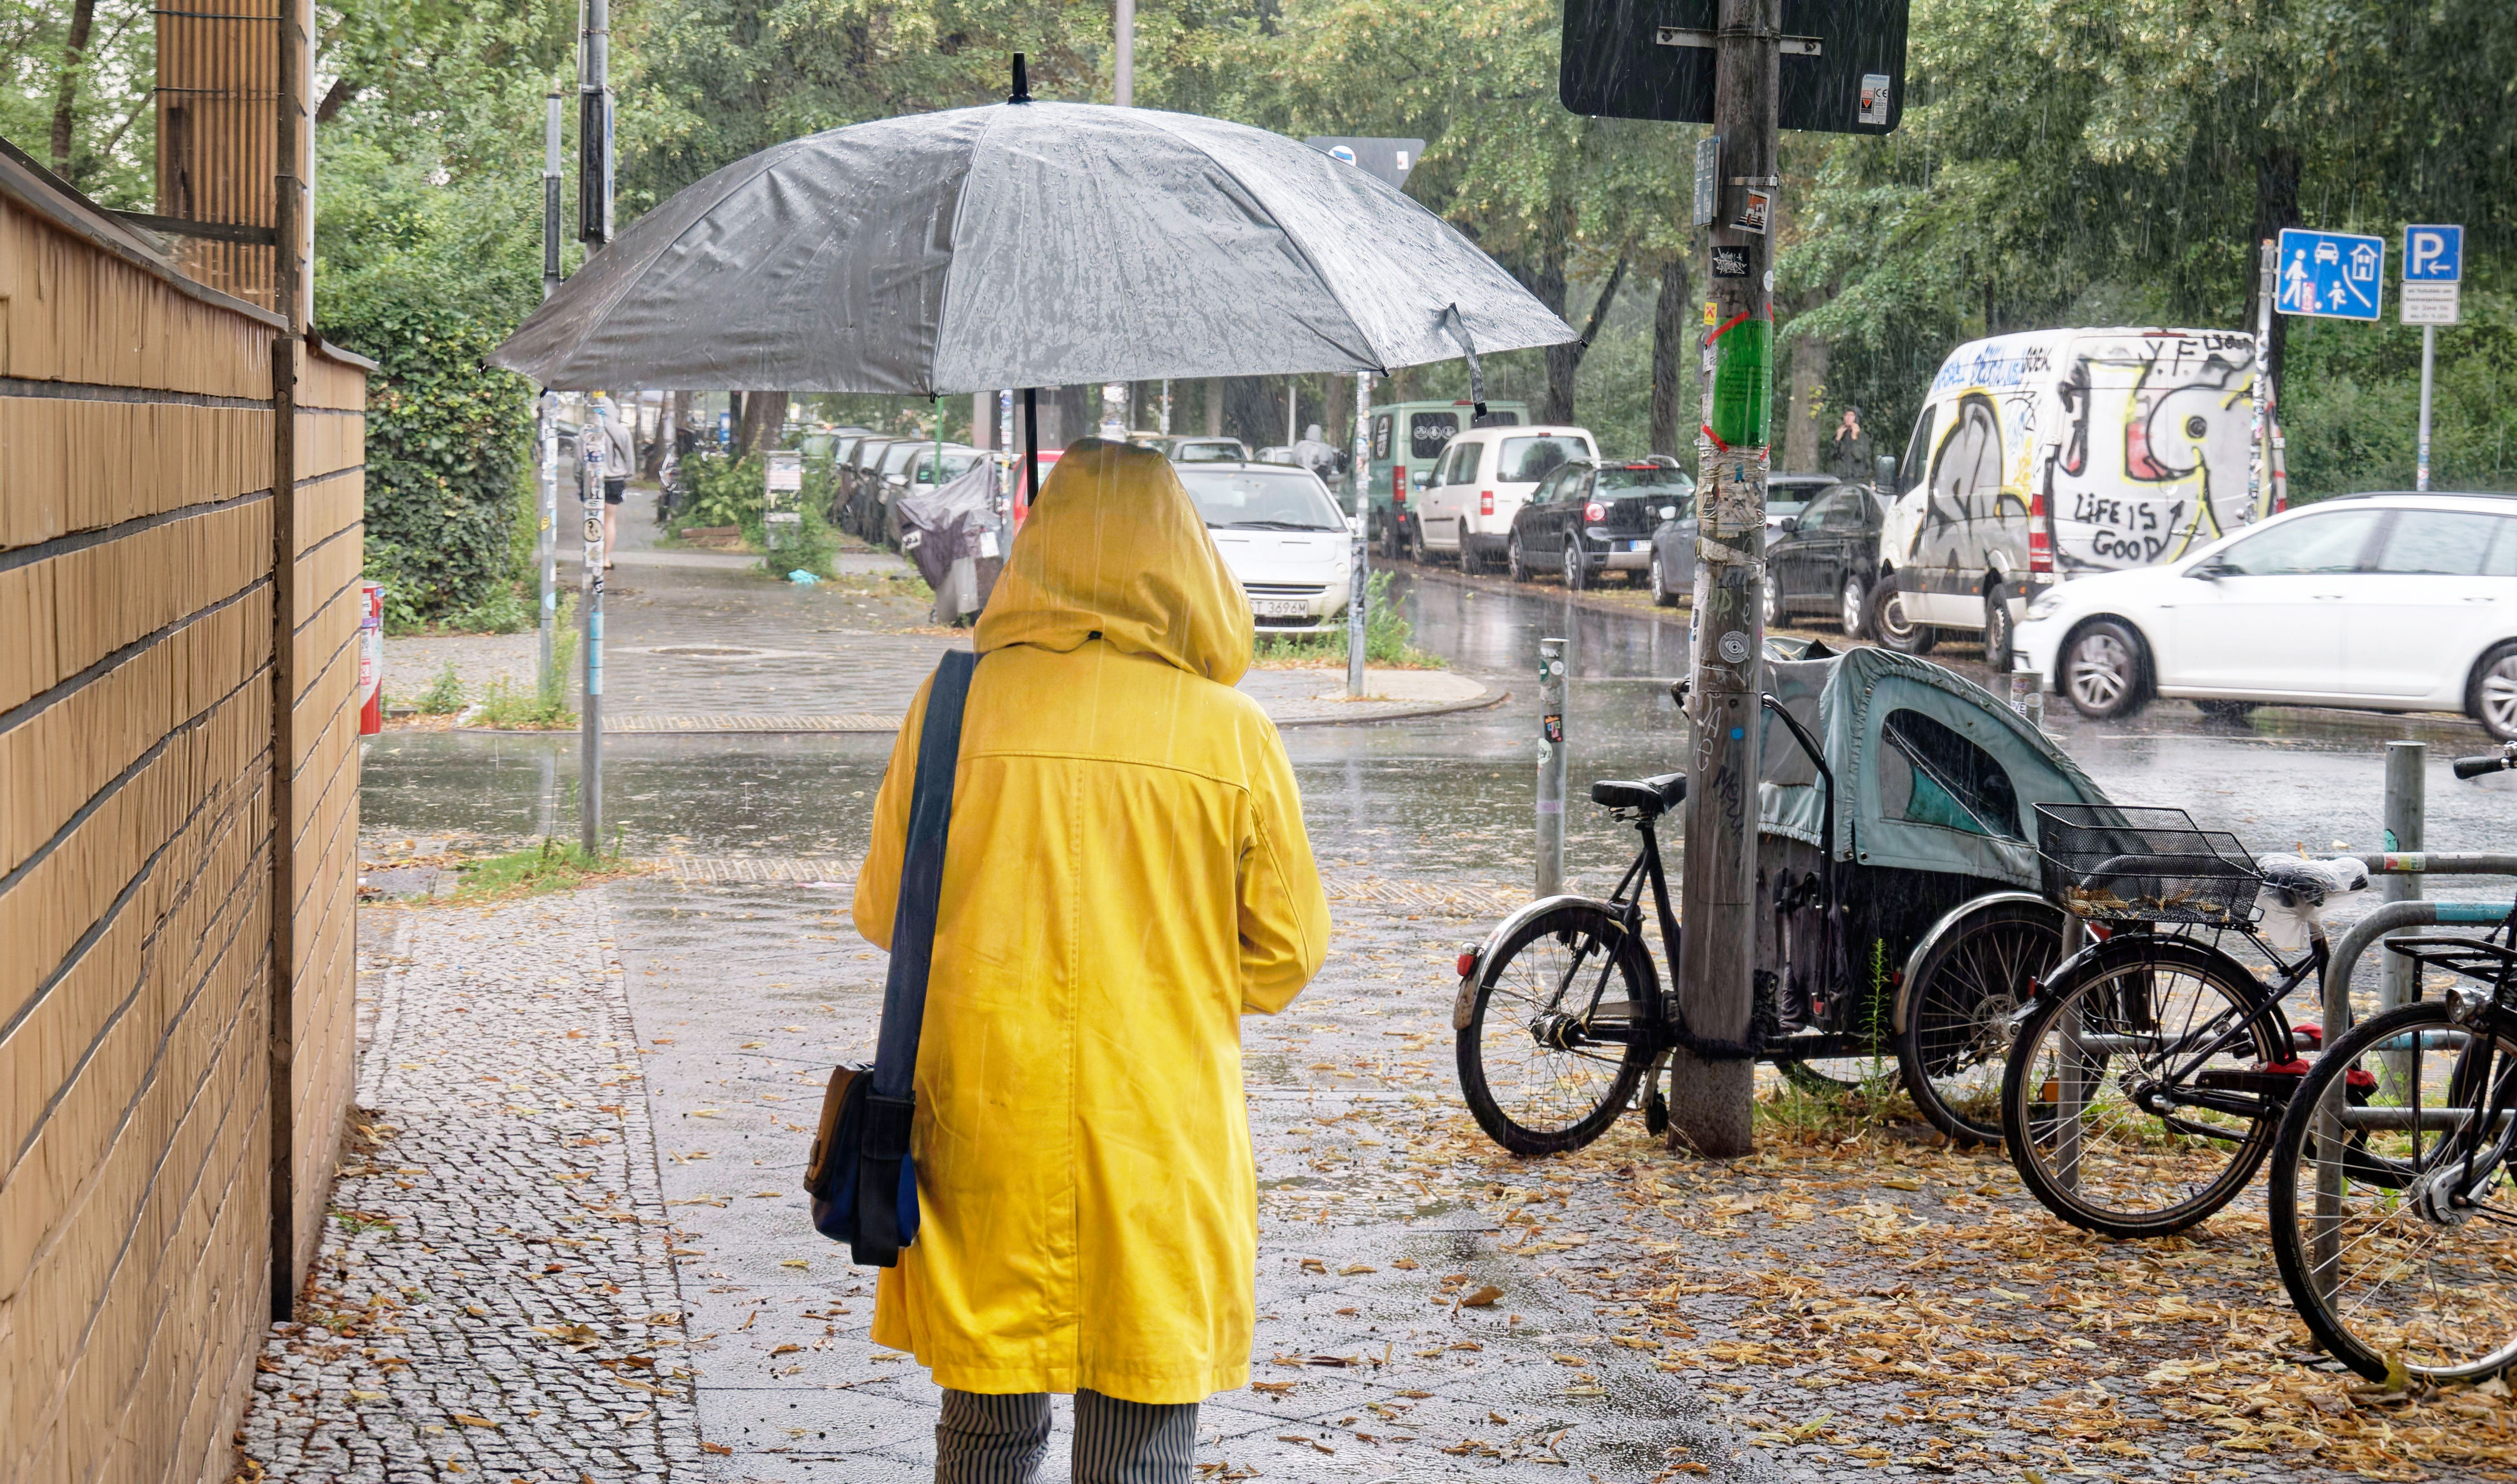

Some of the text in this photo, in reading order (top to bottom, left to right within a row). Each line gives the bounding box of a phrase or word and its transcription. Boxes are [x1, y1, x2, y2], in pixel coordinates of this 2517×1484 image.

[2413, 233, 2444, 274] P
[2128, 502, 2157, 530] IS
[2093, 530, 2163, 562] GOOD
